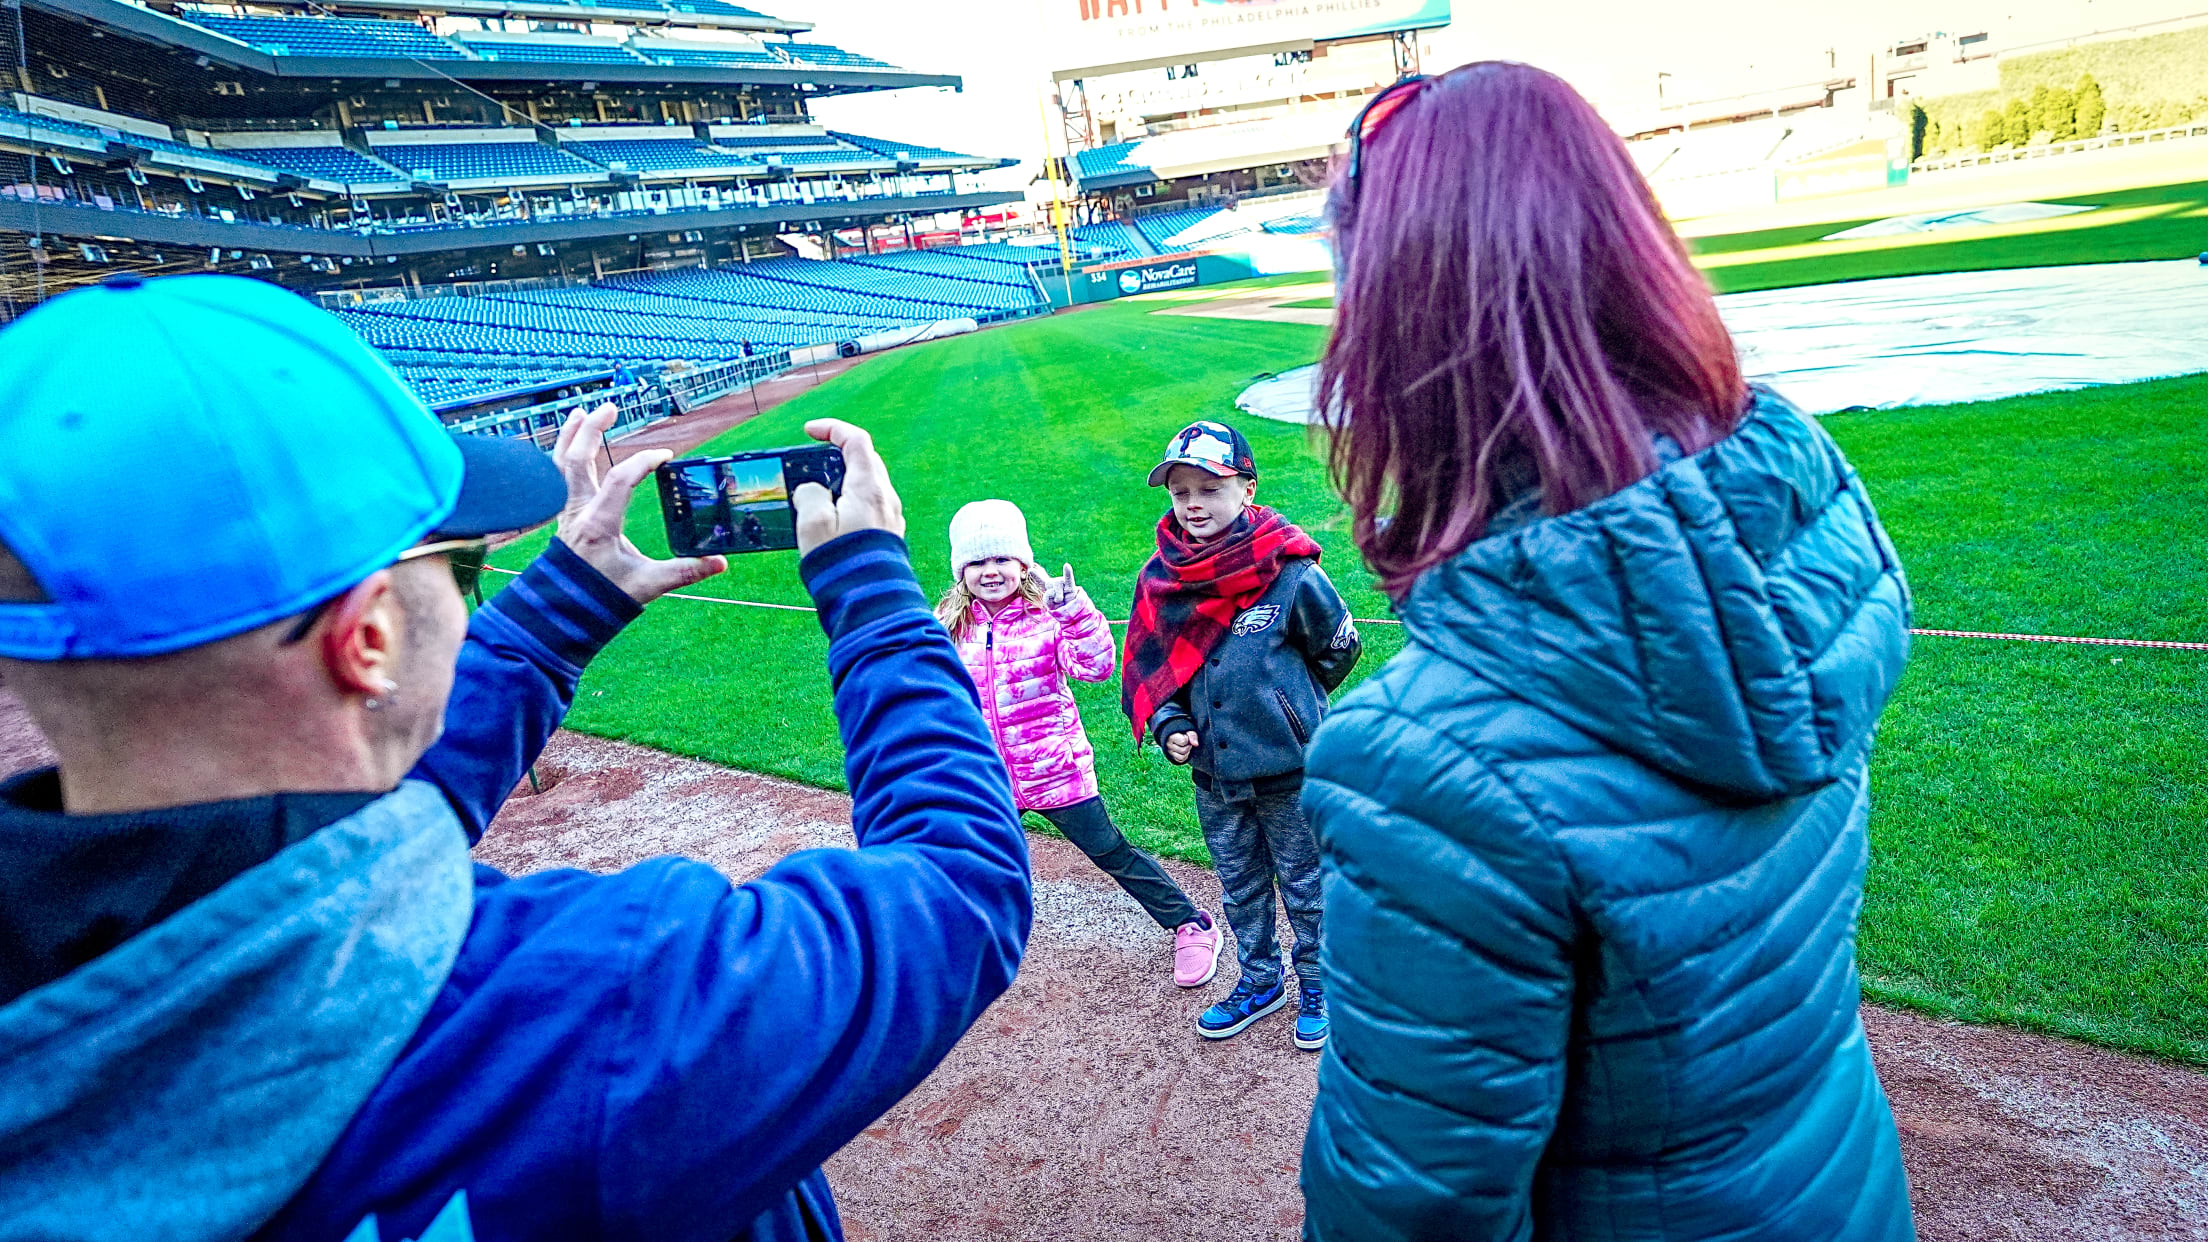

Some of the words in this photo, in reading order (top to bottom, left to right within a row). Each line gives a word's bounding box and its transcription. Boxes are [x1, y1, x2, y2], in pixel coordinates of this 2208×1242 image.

[1118, 25, 1159, 37] FROM
[1168, 20, 1192, 31] THE
[1202, 7, 1308, 27] PHILADELPHIA
[1317, 0, 1380, 12] PHILLIES
[1091, 272, 1107, 283] 334
[1142, 265, 1196, 283] NovaCare
[1178, 427, 1202, 458] P
